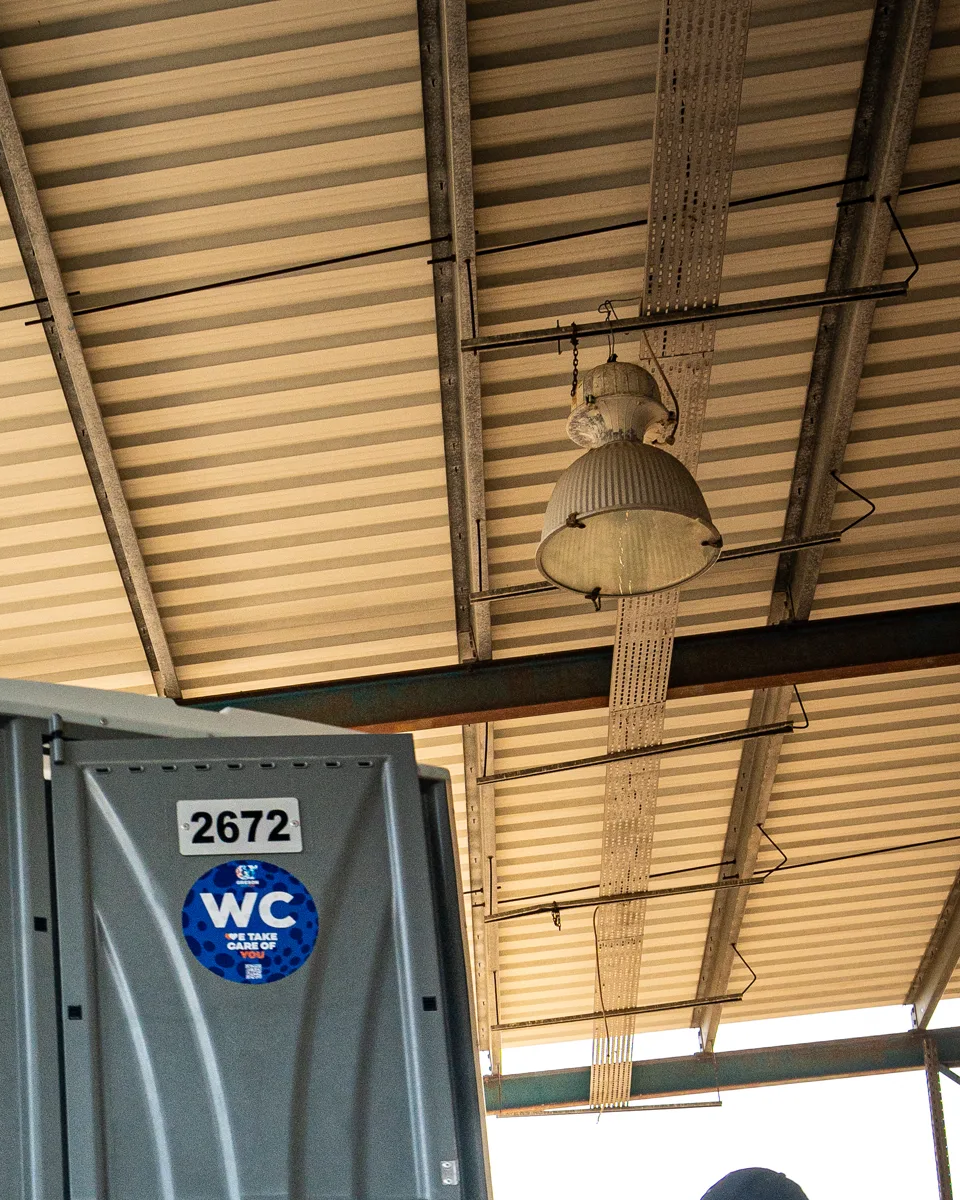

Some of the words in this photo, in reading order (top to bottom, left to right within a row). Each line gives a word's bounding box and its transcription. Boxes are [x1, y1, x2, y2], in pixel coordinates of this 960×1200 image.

[191, 809, 291, 844] 2672
[199, 891, 297, 929] WC
[247, 932, 278, 941] TAKE
[226, 941, 259, 951] CARE
[260, 941, 276, 950] OF
[239, 950, 265, 960] YOU
